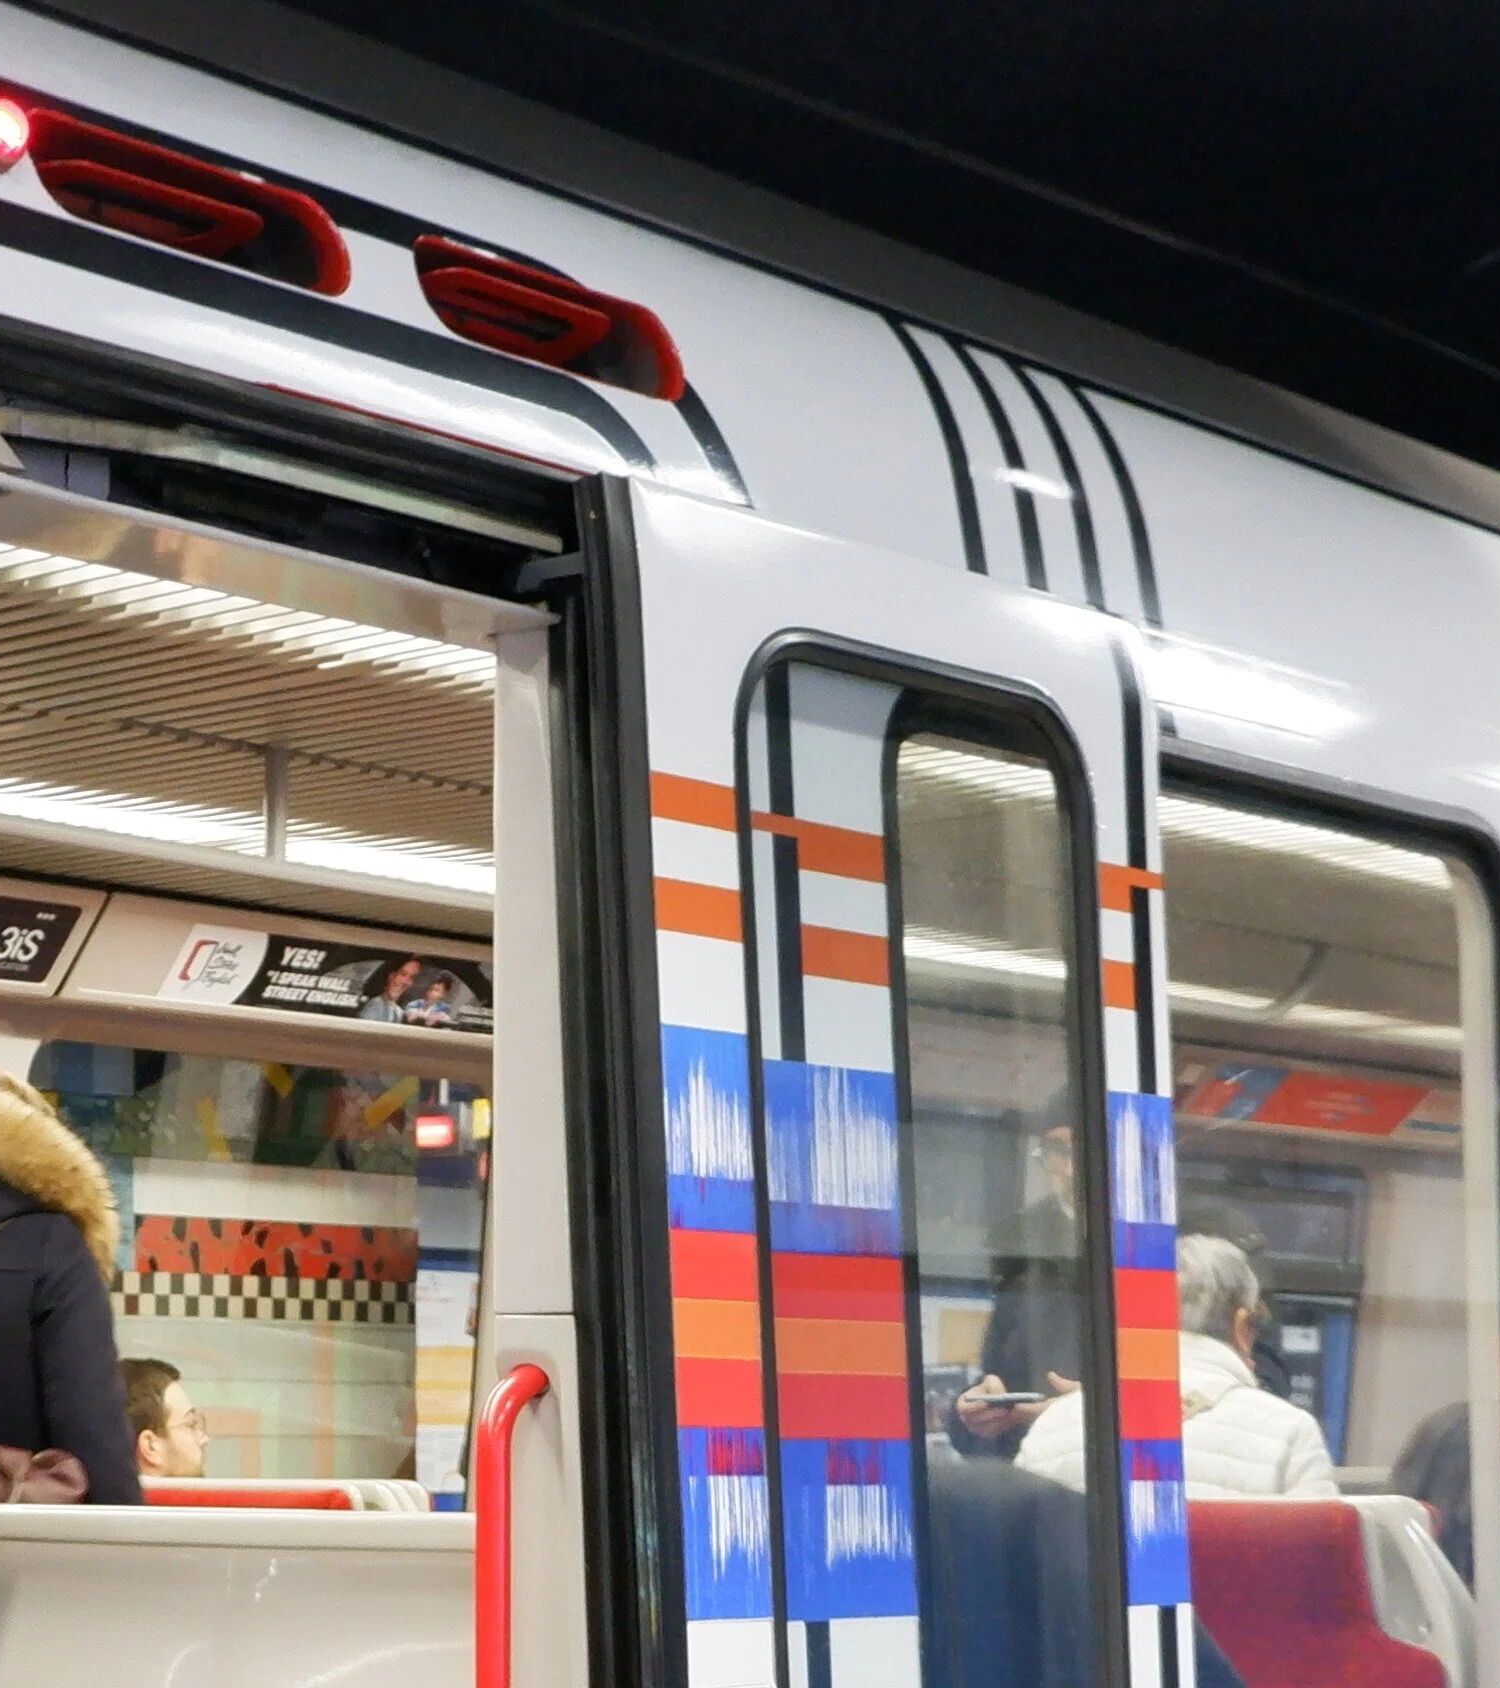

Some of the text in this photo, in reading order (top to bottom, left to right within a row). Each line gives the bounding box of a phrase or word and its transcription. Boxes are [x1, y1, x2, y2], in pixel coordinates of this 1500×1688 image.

[280, 945, 328, 970] YES!
[317, 974, 352, 992] WALL
[261, 984, 310, 1002] STREET
